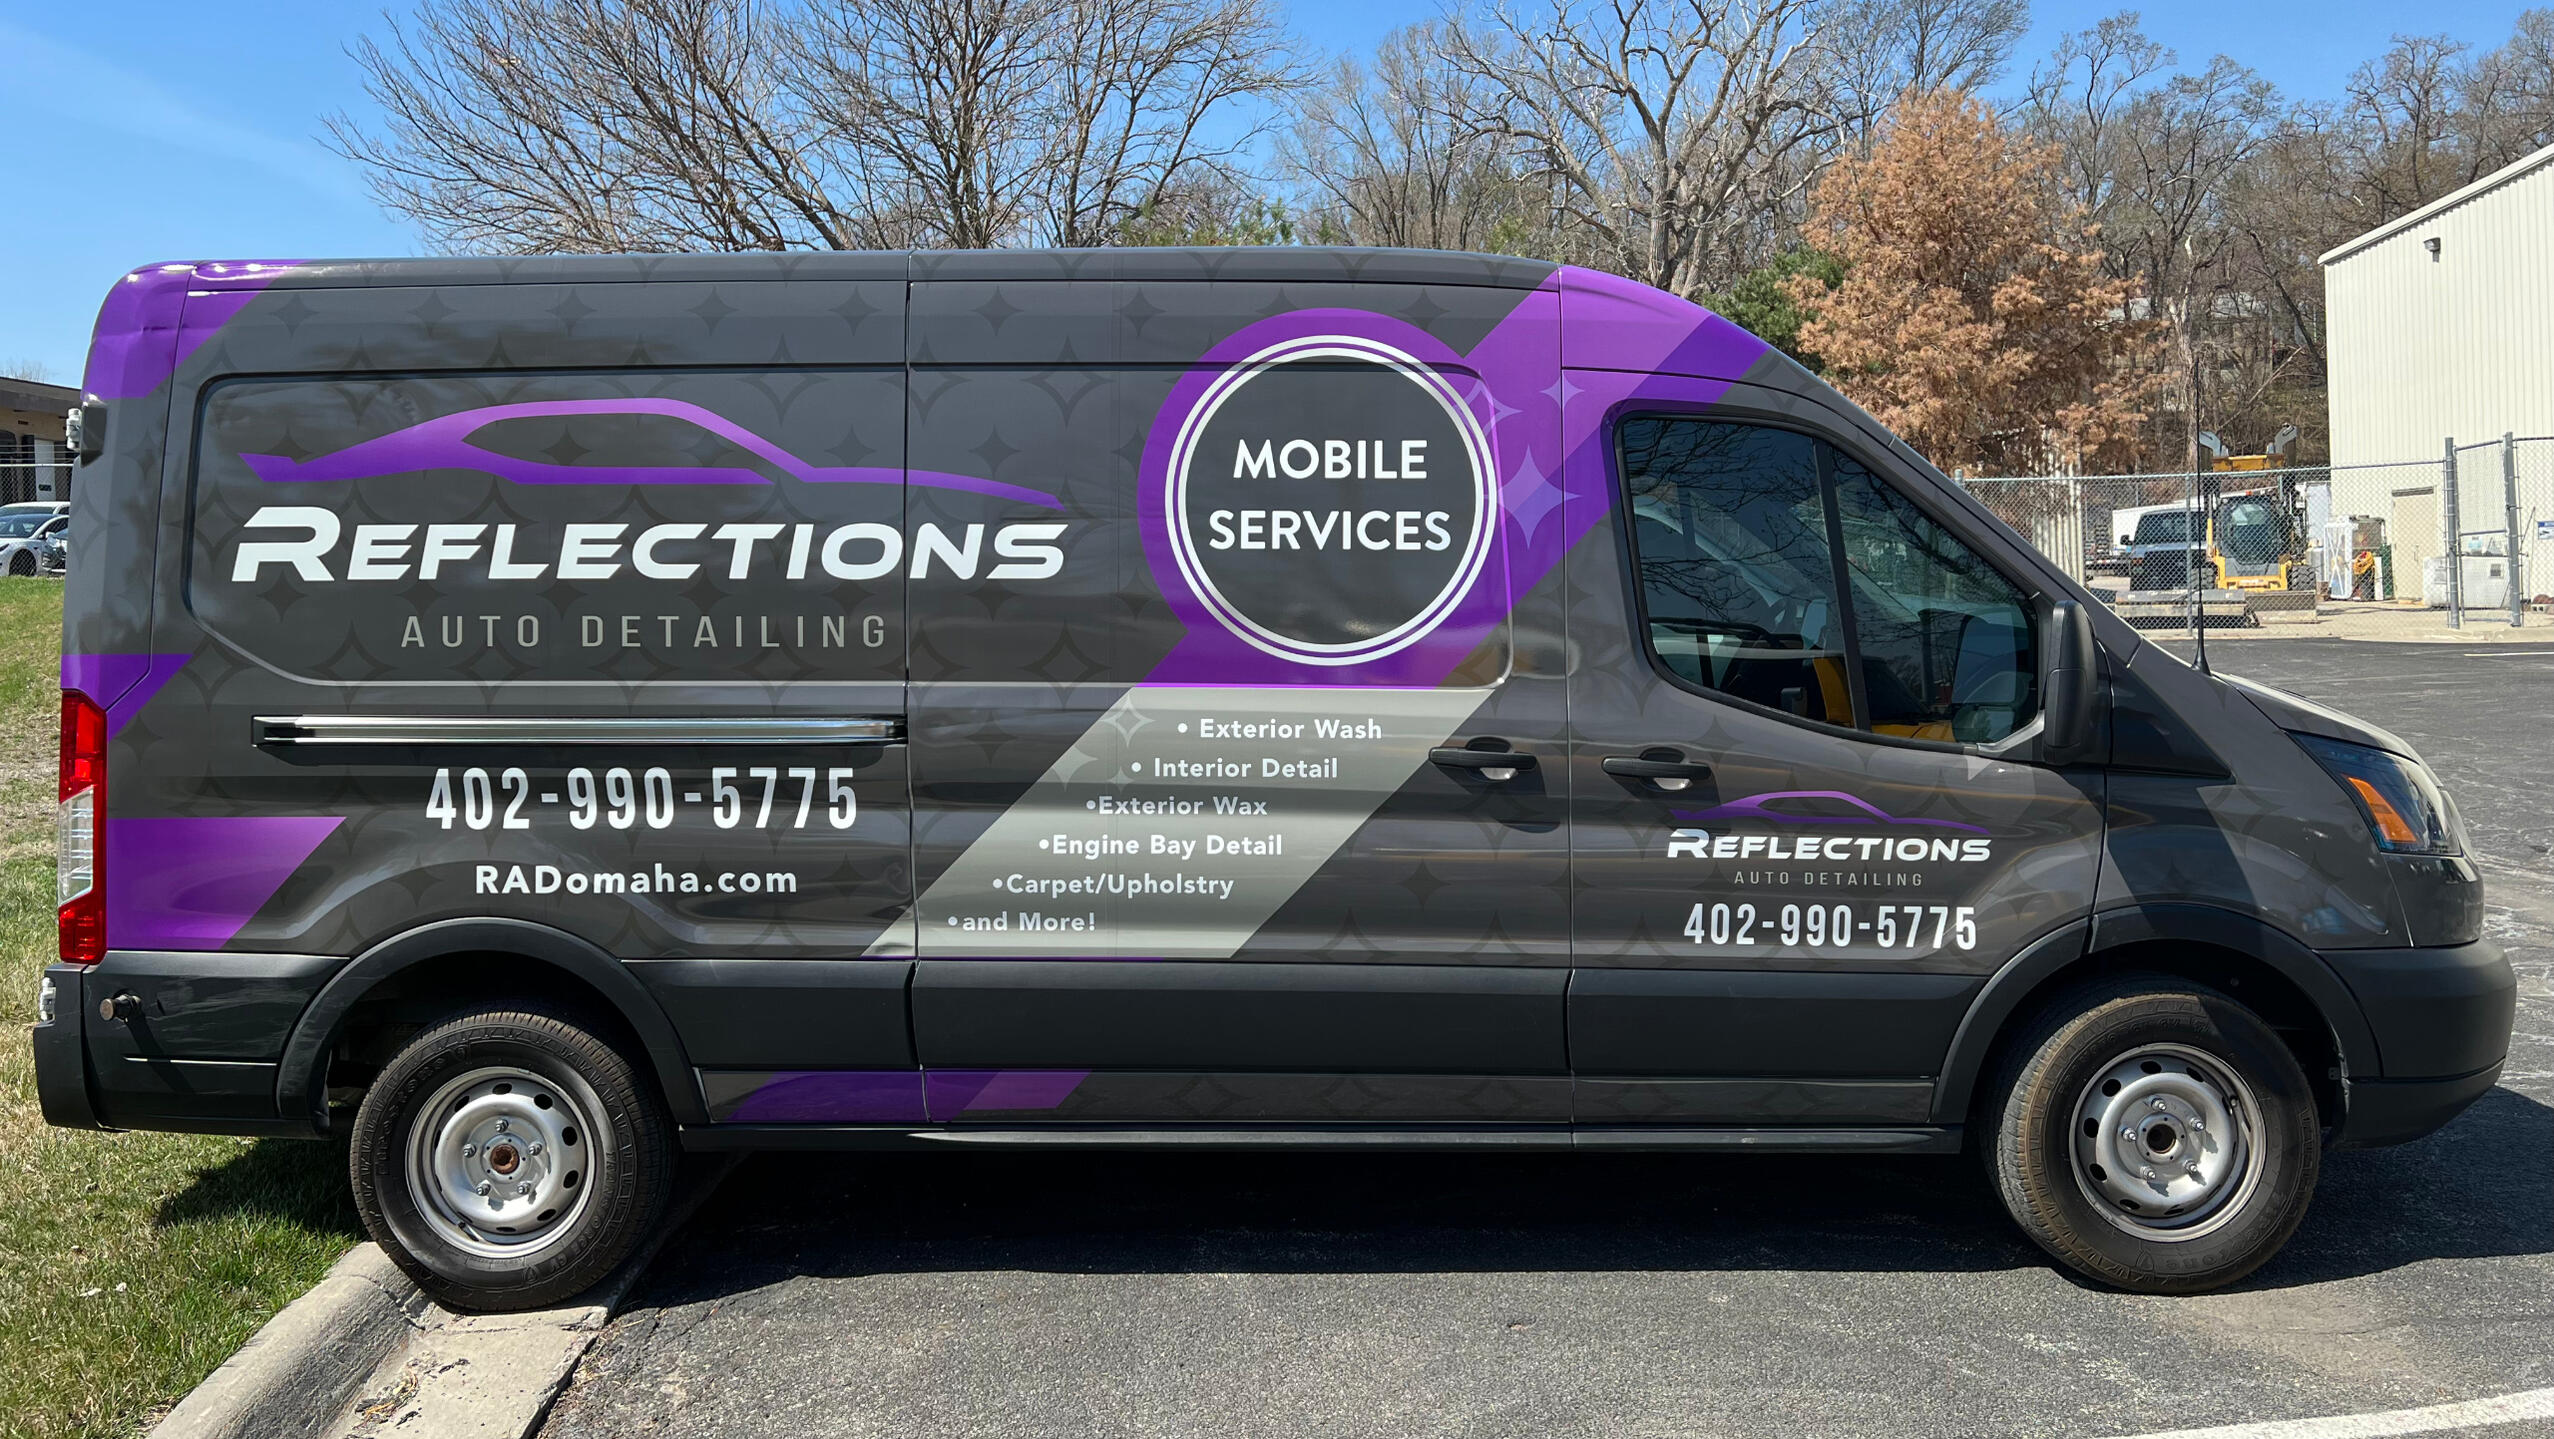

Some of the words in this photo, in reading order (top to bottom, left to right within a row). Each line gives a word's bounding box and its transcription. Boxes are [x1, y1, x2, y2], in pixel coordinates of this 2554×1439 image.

[1232, 438, 1429, 480] MOBILE
[230, 506, 1069, 583] REFLECTIONS
[1208, 508, 1452, 552] SERVICES
[400, 614, 541, 649] AUTO
[581, 614, 885, 649] DETAILING
[1199, 717, 1305, 740] Exterior
[1313, 717, 1383, 740] Wash
[1153, 756, 1253, 779] Interior
[1261, 756, 1339, 779] Detail
[424, 766, 858, 831] 402-990-5775
[1098, 795, 1204, 817] Exterior
[1212, 796, 1268, 817] Wax
[1052, 832, 1141, 861] Engine
[1150, 834, 1198, 861] Bay
[1206, 833, 1284, 857] Detail
[1666, 828, 1993, 863] REFLECTIONS
[475, 861, 798, 895] RADomaha.com
[1734, 870, 1790, 886] AUTO
[1804, 871, 1923, 888] DETAILING
[962, 911, 1010, 932] and
[1018, 912, 1098, 932] More!
[1683, 902, 1978, 951] 402-990-5775
